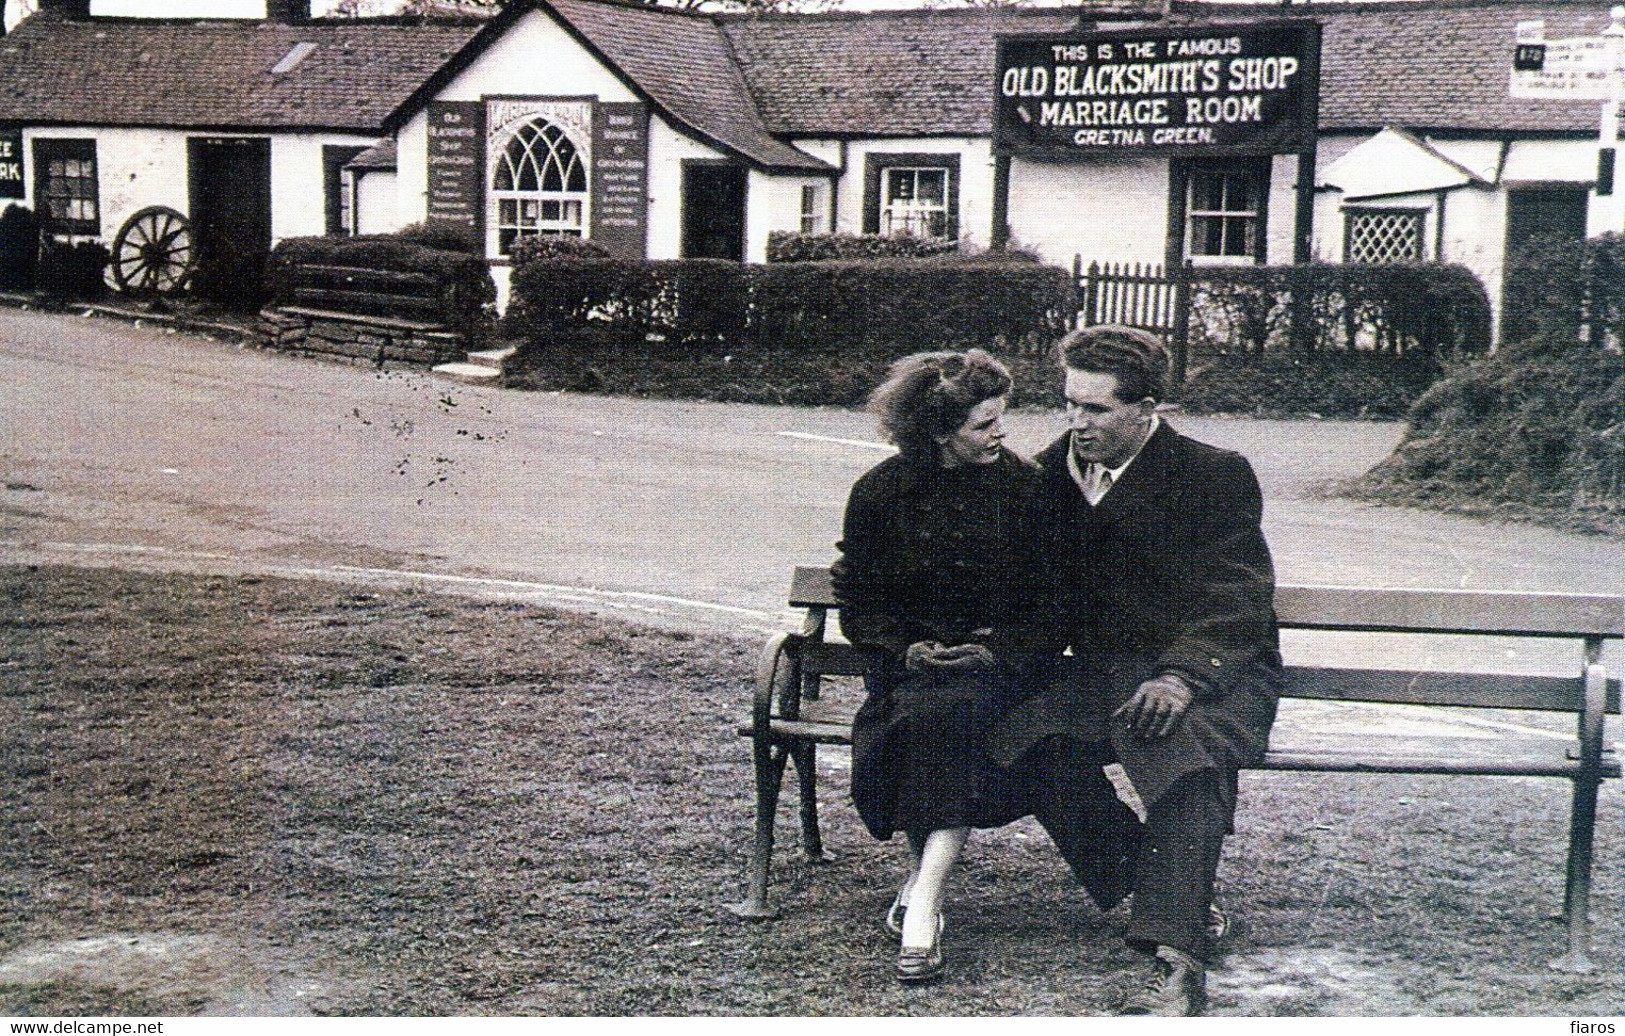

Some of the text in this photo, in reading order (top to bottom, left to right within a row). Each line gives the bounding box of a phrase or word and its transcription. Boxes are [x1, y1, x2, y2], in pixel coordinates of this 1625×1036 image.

[1051, 37, 1242, 61] THIS IS THE FAMOUS
[1002, 57, 1299, 97] OLD BLACKSMITH'S SHOP
[1039, 95, 1263, 126] MARRIAGE ROOM
[1074, 128, 1145, 145] GRETNA
